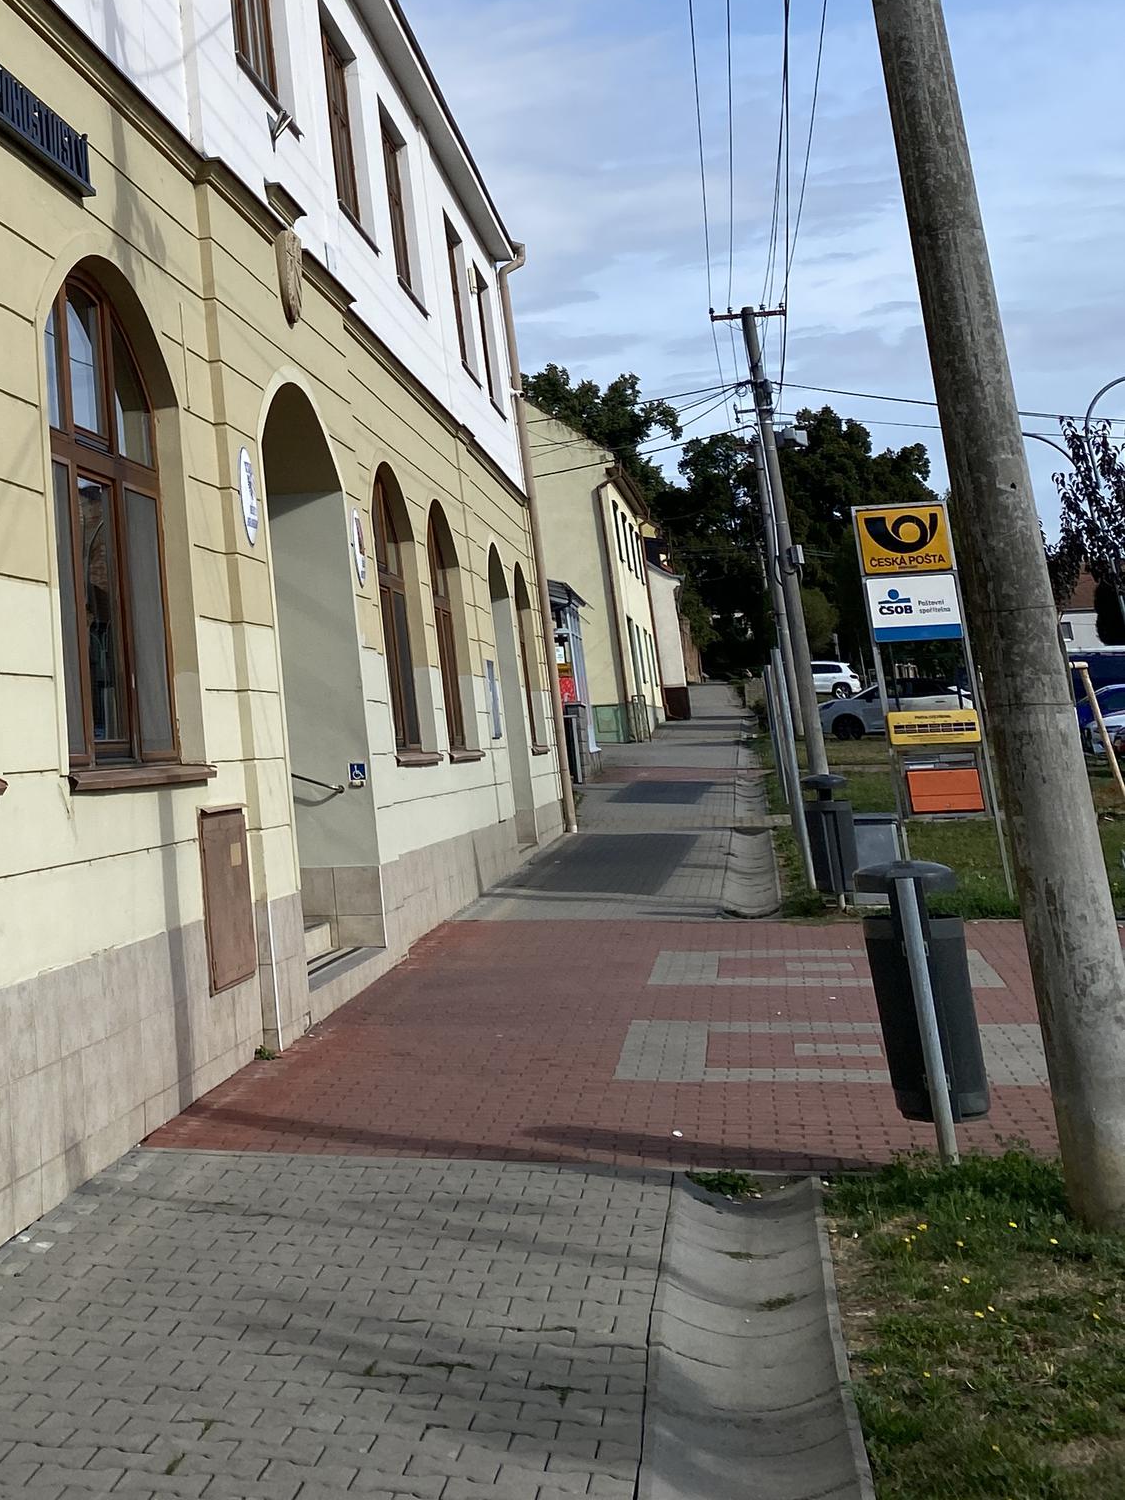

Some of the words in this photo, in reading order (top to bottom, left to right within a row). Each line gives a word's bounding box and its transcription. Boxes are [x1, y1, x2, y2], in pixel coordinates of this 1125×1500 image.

[870, 555, 907, 567] ČESKÁ
[909, 553, 946, 565] POŠTA
[879, 605, 913, 616] ČSOB
